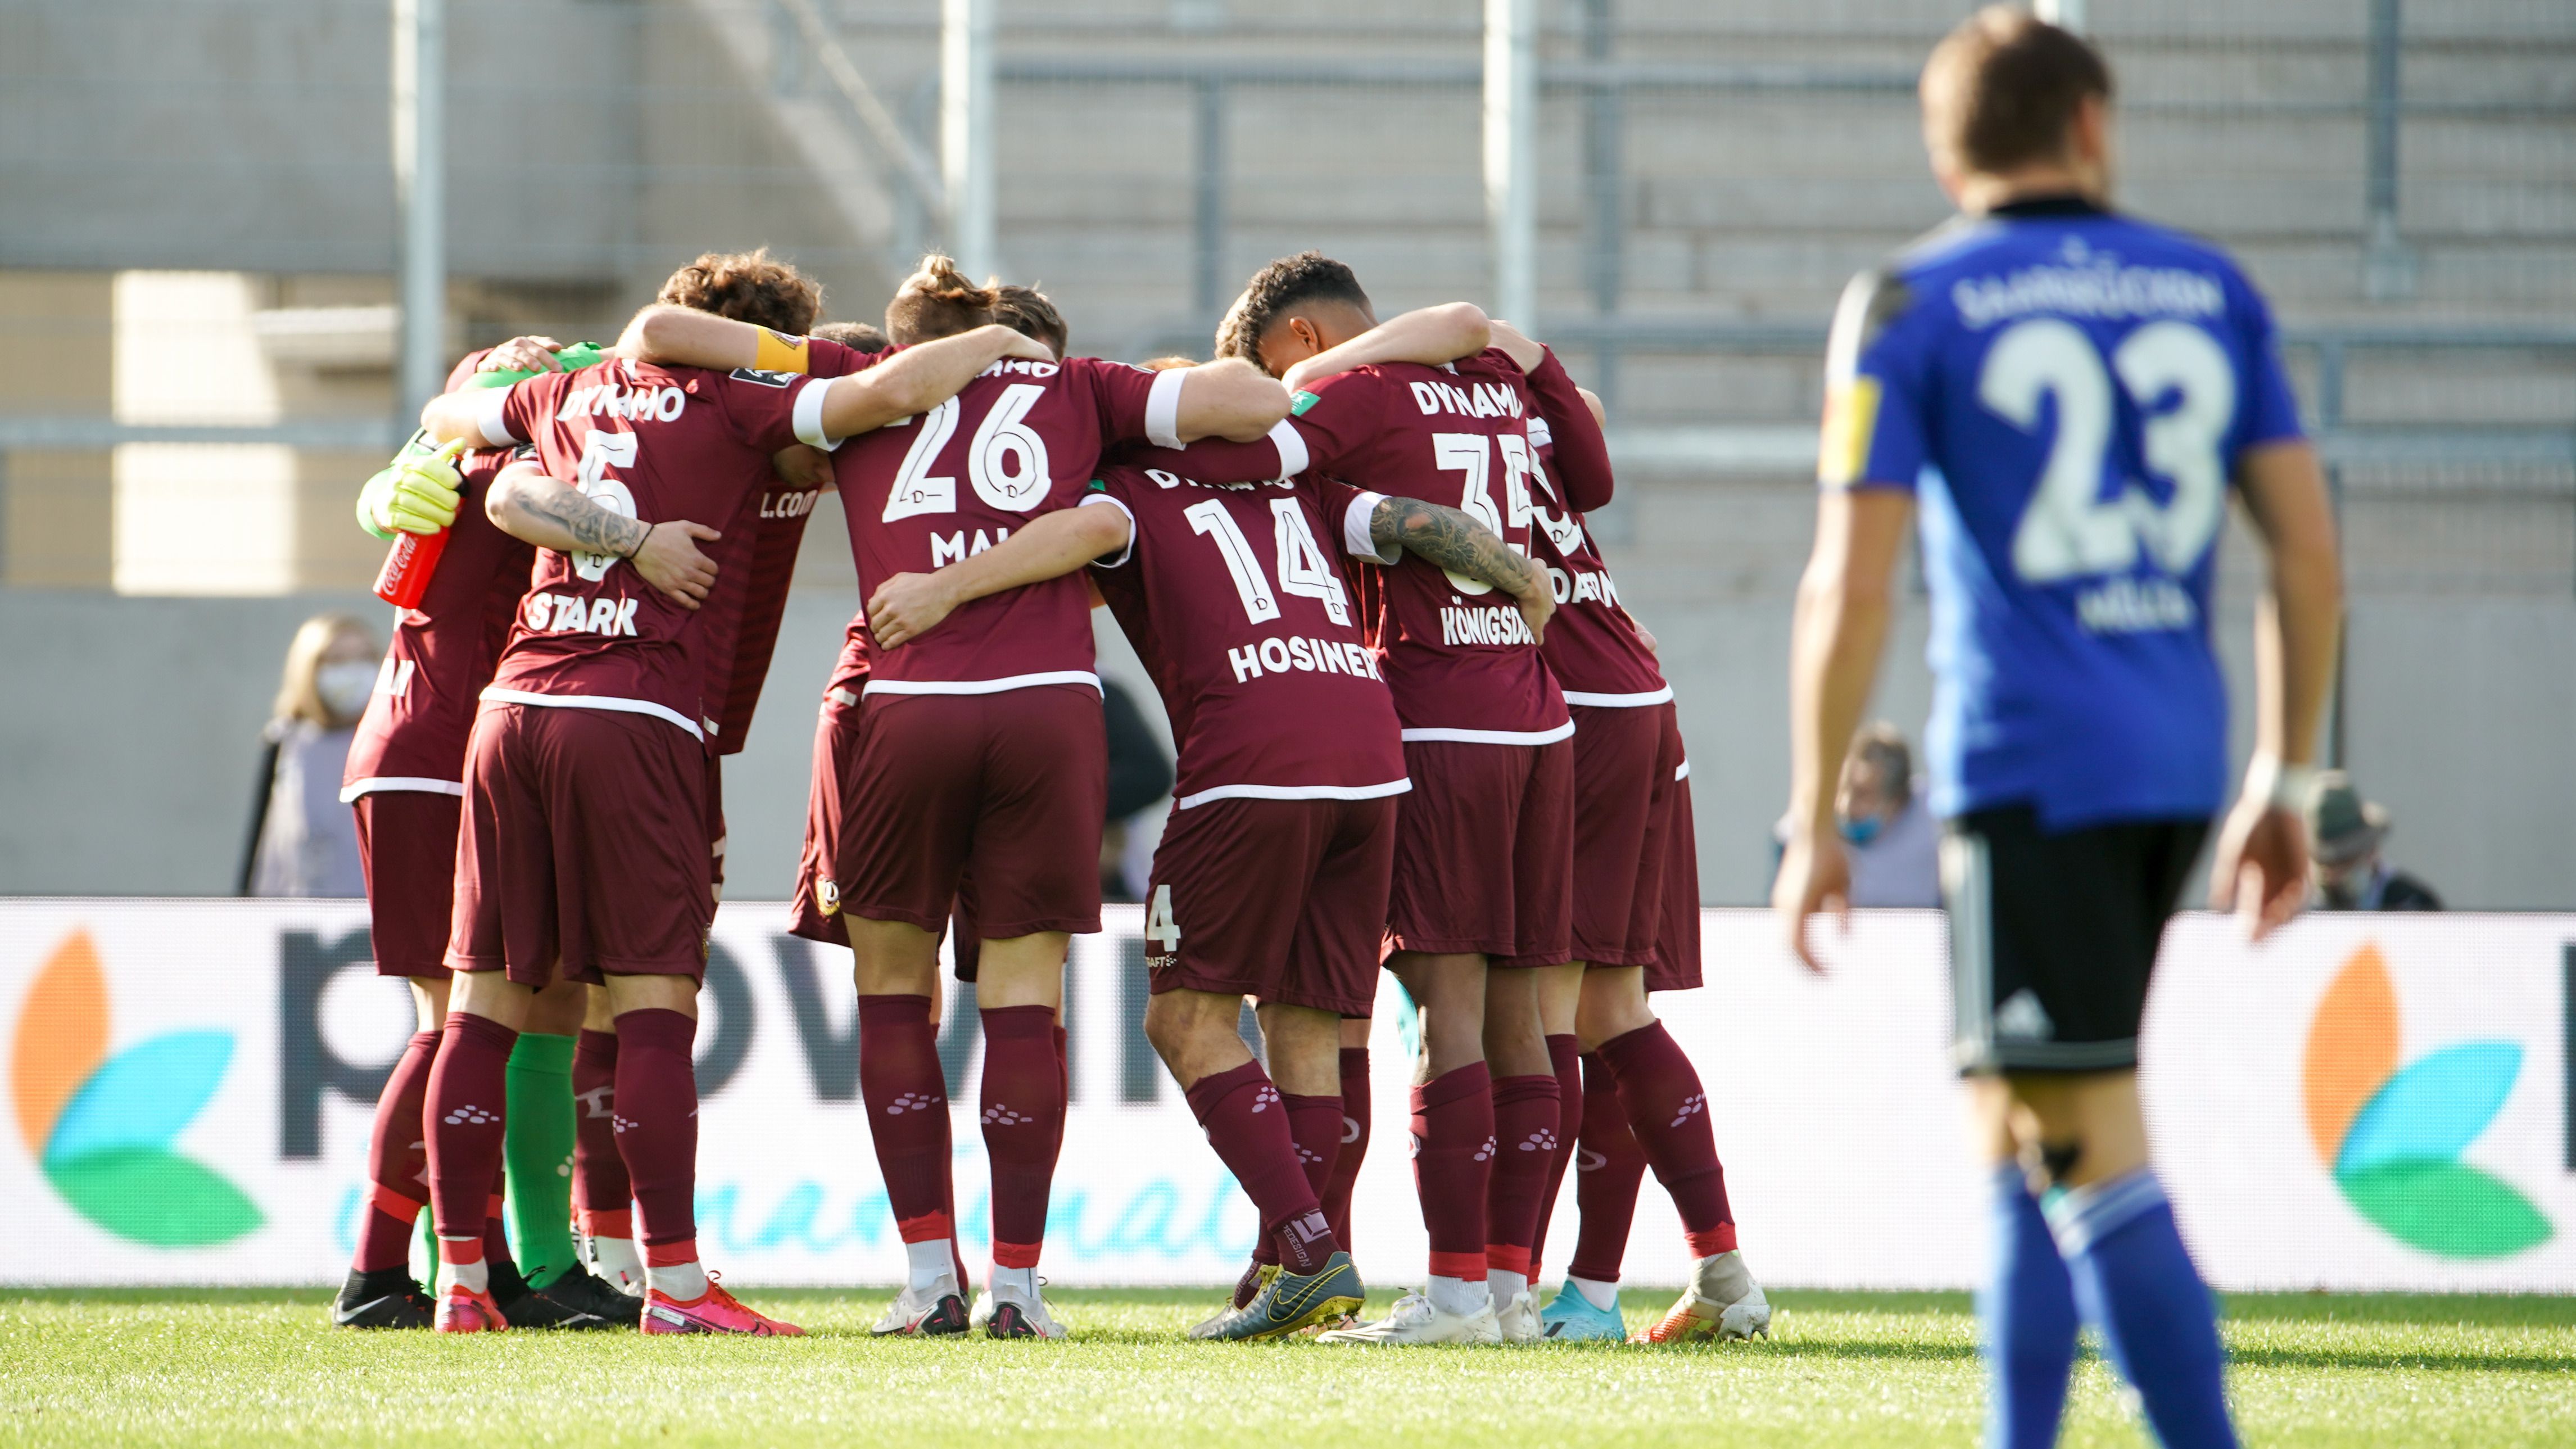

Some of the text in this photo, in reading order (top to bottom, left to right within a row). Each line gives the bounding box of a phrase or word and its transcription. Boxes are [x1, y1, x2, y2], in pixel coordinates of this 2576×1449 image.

[555, 383, 686, 422] DYNAMO
[881, 383, 1052, 523] 26
[1976, 318, 2237, 586] 23
[1183, 496, 1352, 628] 14
[527, 592, 639, 636] STARK
[1228, 636, 1384, 684] HOSINER
